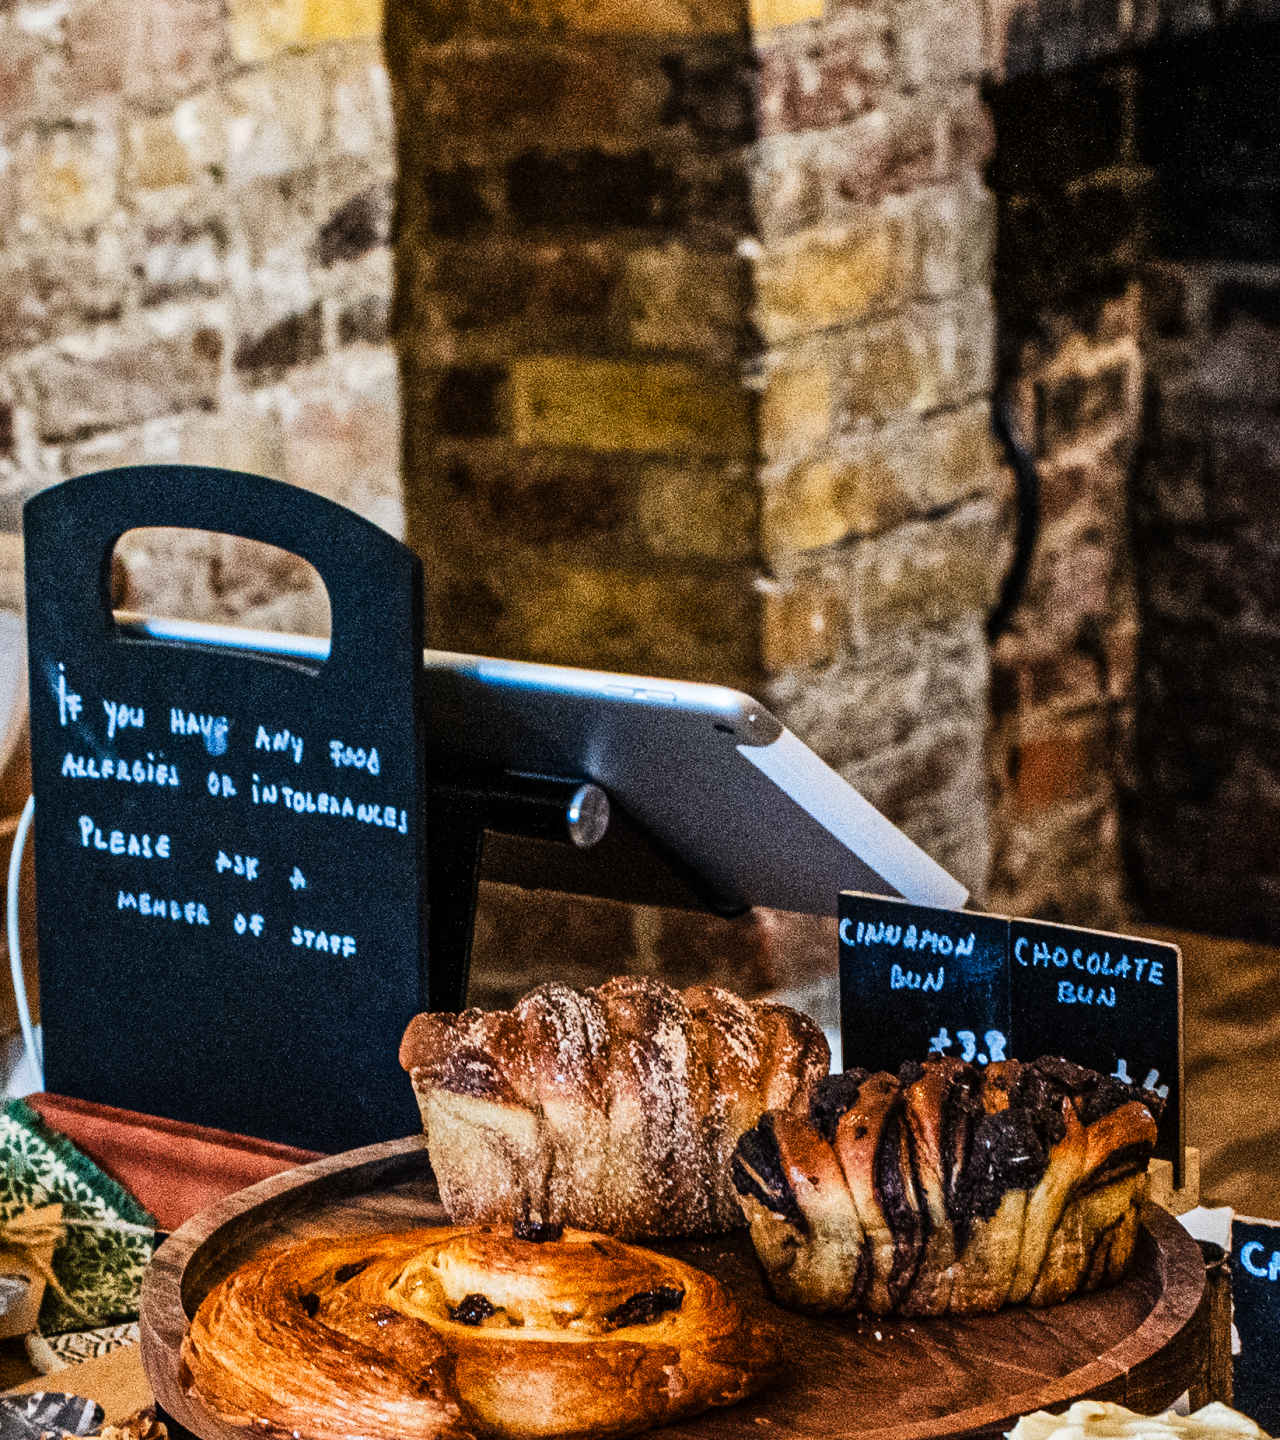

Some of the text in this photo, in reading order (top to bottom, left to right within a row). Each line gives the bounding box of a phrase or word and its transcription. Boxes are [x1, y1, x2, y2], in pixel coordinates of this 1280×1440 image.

[104, 701, 144, 737] YOU
[171, 708, 228, 750] HAVE
[256, 726, 303, 762] ANY
[330, 740, 380, 775] FOOD
[208, 771, 237, 797] OR
[78, 815, 306, 888] PLEASE ASK A
[118, 891, 356, 956] MEMBER OF STAFF
[838, 917, 976, 956] CINNAMON
[889, 965, 945, 992] BUN
[1014, 936, 1166, 985] CHOCOLATE
[1057, 981, 1116, 1007] BUN
